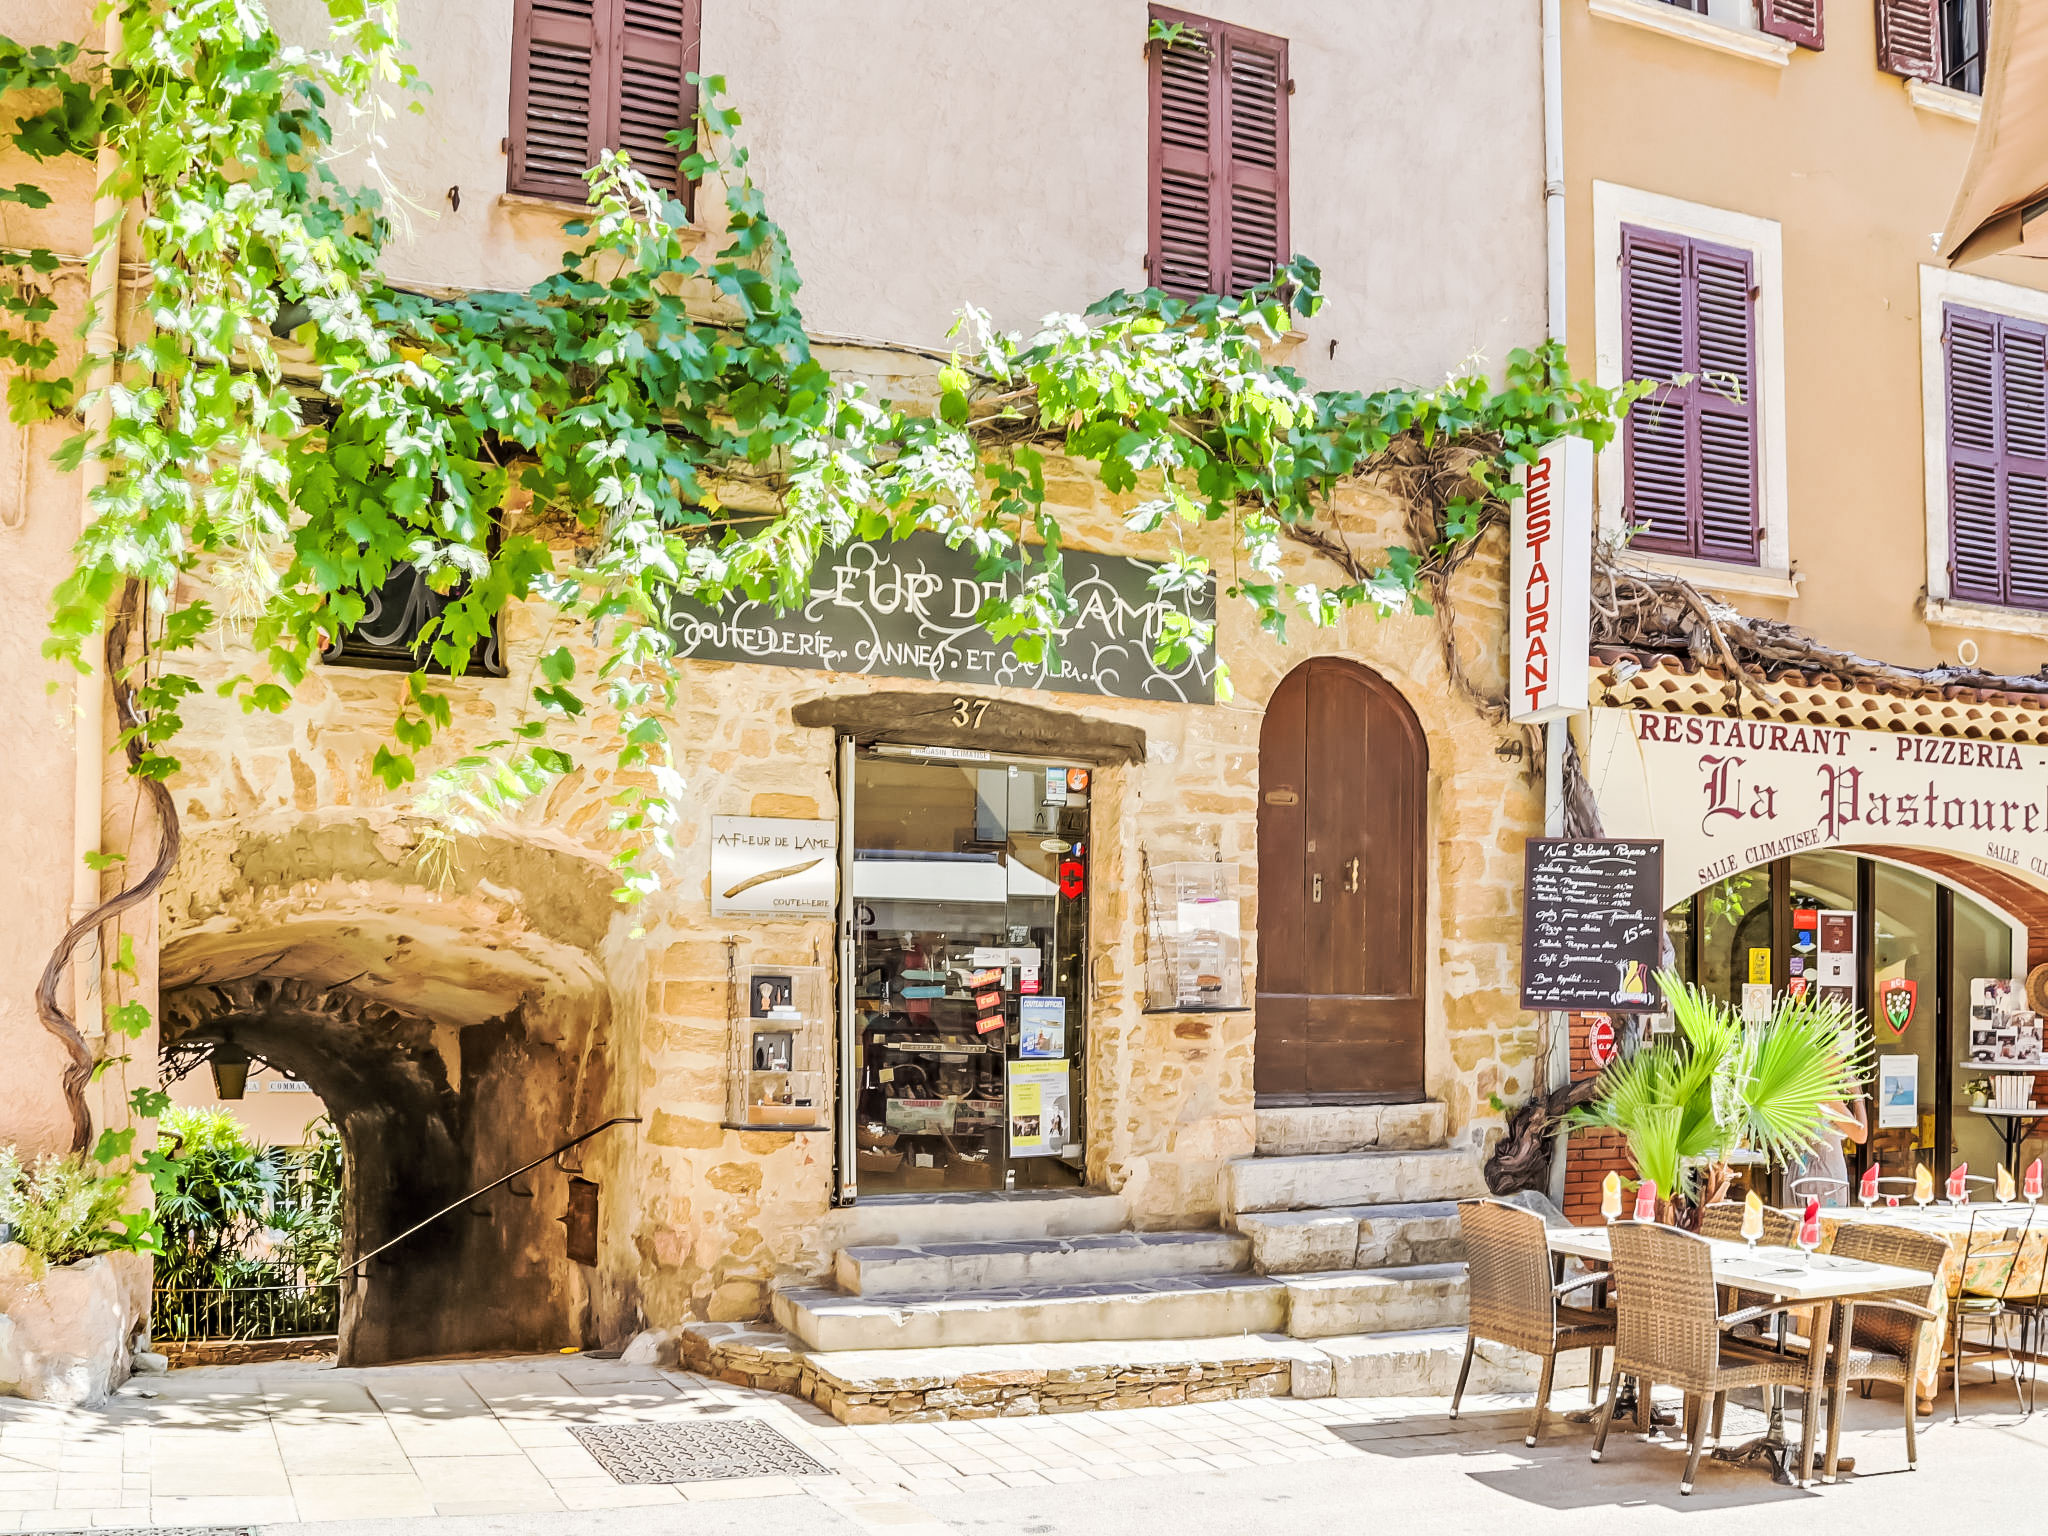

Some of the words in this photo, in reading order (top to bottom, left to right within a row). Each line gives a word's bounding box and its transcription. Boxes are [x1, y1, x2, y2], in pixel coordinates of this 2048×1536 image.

[1525, 457, 1551, 712] RESTAURANT
[966, 649, 995, 672] ET
[952, 697, 991, 729] 37
[1638, 714, 1850, 756] RESTAURANT
[1896, 736, 2023, 770] PIZZERIA
[1698, 754, 1779, 837] La
[1816, 763, 2048, 842] Pastoure
[732, 832, 771, 848] FLEUR
[775, 836, 789, 847] DE
[794, 836, 832, 850] LAME
[1698, 854, 1738, 885] SALLE
[1744, 827, 1821, 865] CLIMATISEE
[1986, 841, 2020, 865] SALLE
[773, 898, 830, 908] COUTELLERIE
